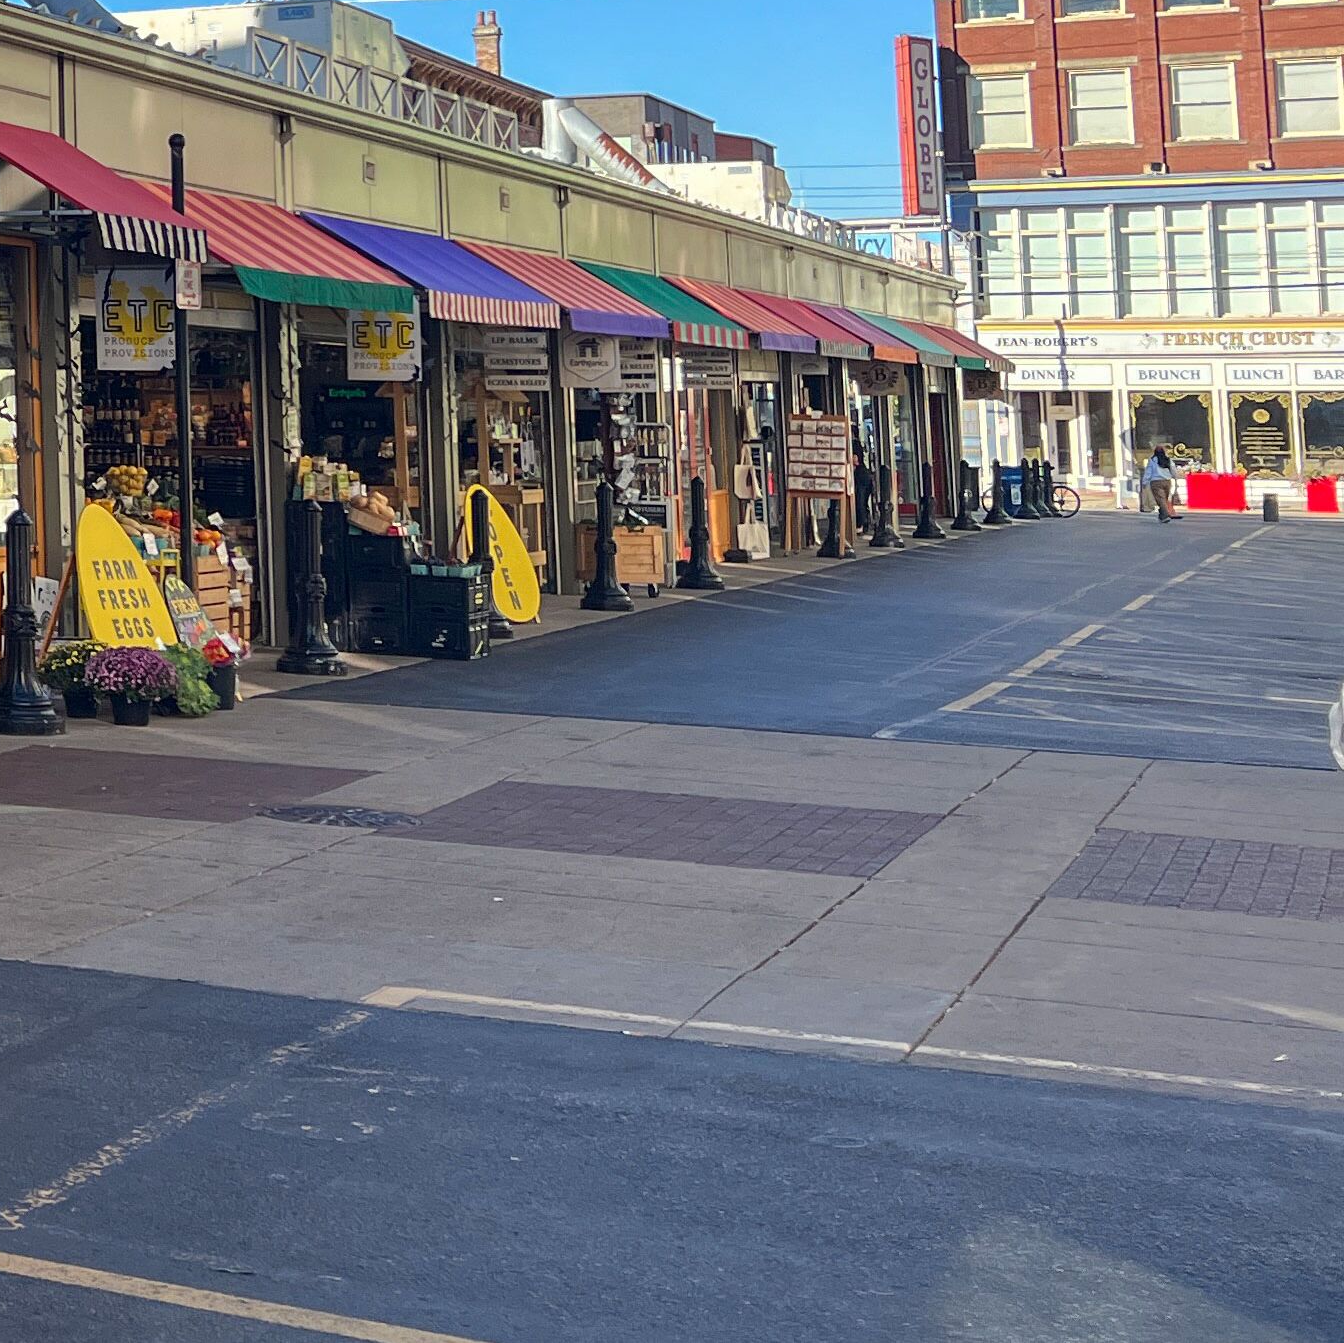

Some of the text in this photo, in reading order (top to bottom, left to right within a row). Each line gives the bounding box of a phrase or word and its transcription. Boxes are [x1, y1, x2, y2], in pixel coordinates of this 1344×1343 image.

[914, 57, 934, 195] GLOBE
[101, 299, 175, 333] ETC
[103, 336, 155, 345] PRODUCE
[351, 320, 415, 349] ETC
[491, 336, 539, 345] LIP BALMS
[1162, 331, 1315, 346] FRENCH CRUST
[995, 335, 1098, 347] JEAN-ROBERT'S
[104, 348, 175, 358] PROVISIONS
[489, 357, 542, 366] GEMSTONES
[1021, 369, 1075, 380] DINNER
[1137, 369, 1201, 380] BRUNCH
[1232, 369, 1284, 380] LUNCH
[487, 379, 519, 387] ECZEMA
[91, 559, 139, 581] FARM
[488, 521, 523, 611] OPEN
[97, 587, 152, 611] FRESH
[111, 616, 156, 640] EGGS
